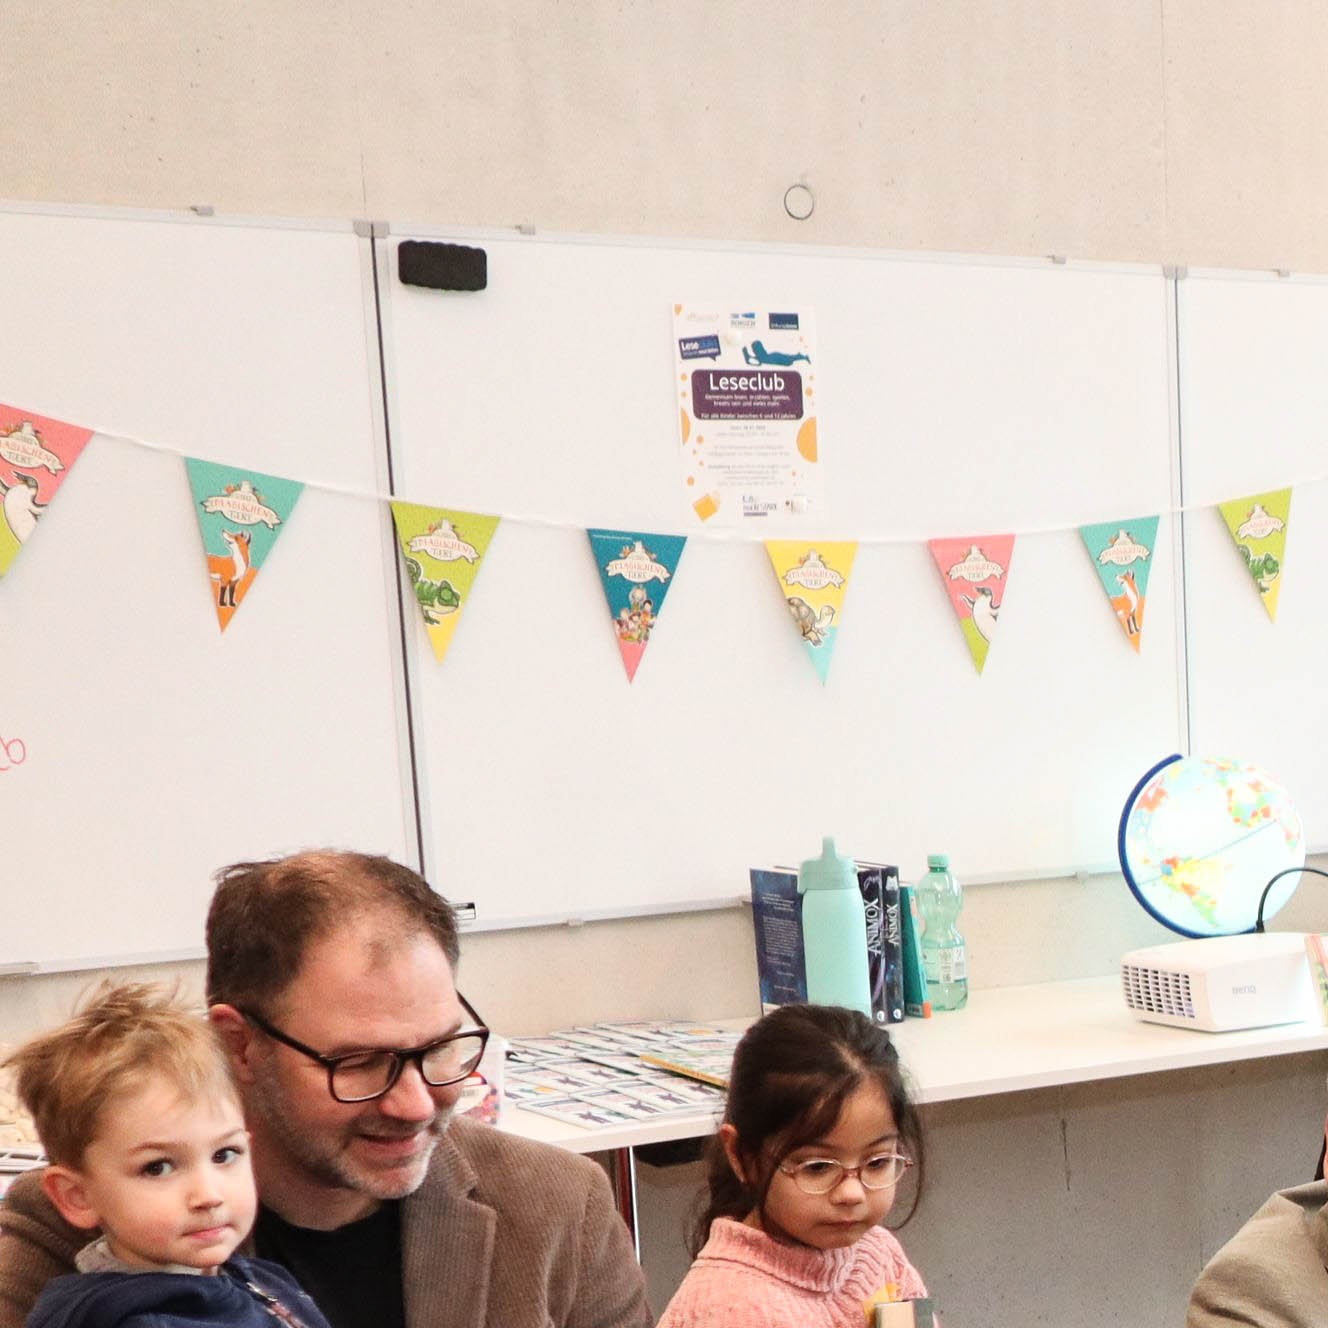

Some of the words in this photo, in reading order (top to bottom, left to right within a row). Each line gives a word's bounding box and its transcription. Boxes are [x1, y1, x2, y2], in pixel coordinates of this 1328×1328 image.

[709, 372, 785, 391] Leseclub
[864, 897, 882, 957] ANIMOX
[886, 903, 900, 946] ANIMOX
